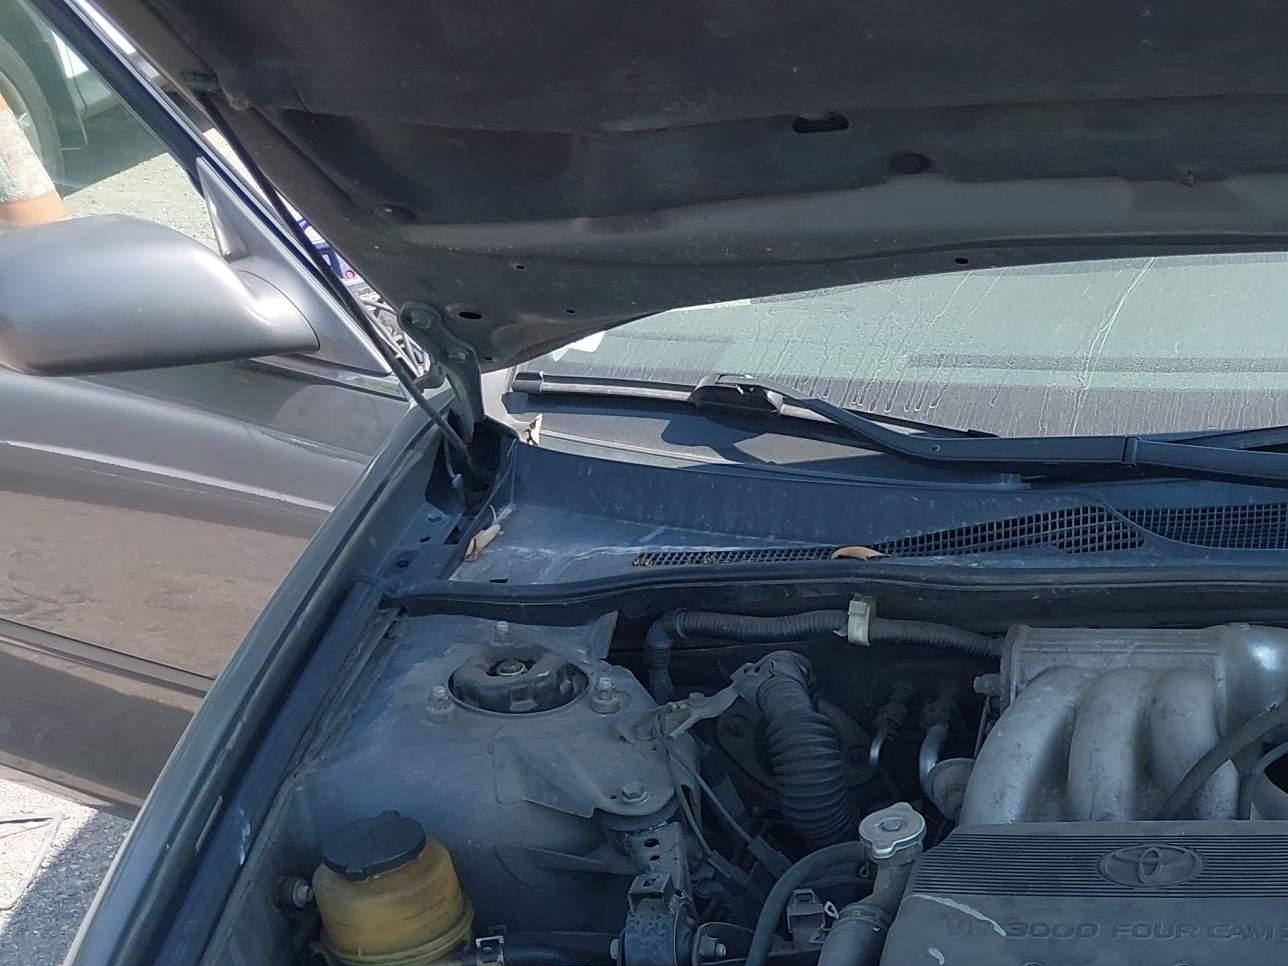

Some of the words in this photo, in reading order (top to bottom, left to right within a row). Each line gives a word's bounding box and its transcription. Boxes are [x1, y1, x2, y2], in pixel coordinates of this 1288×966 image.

[1005, 921, 1100, 940] 3000
[1111, 921, 1199, 940] FOUR
[1206, 921, 1274, 940] CAM
